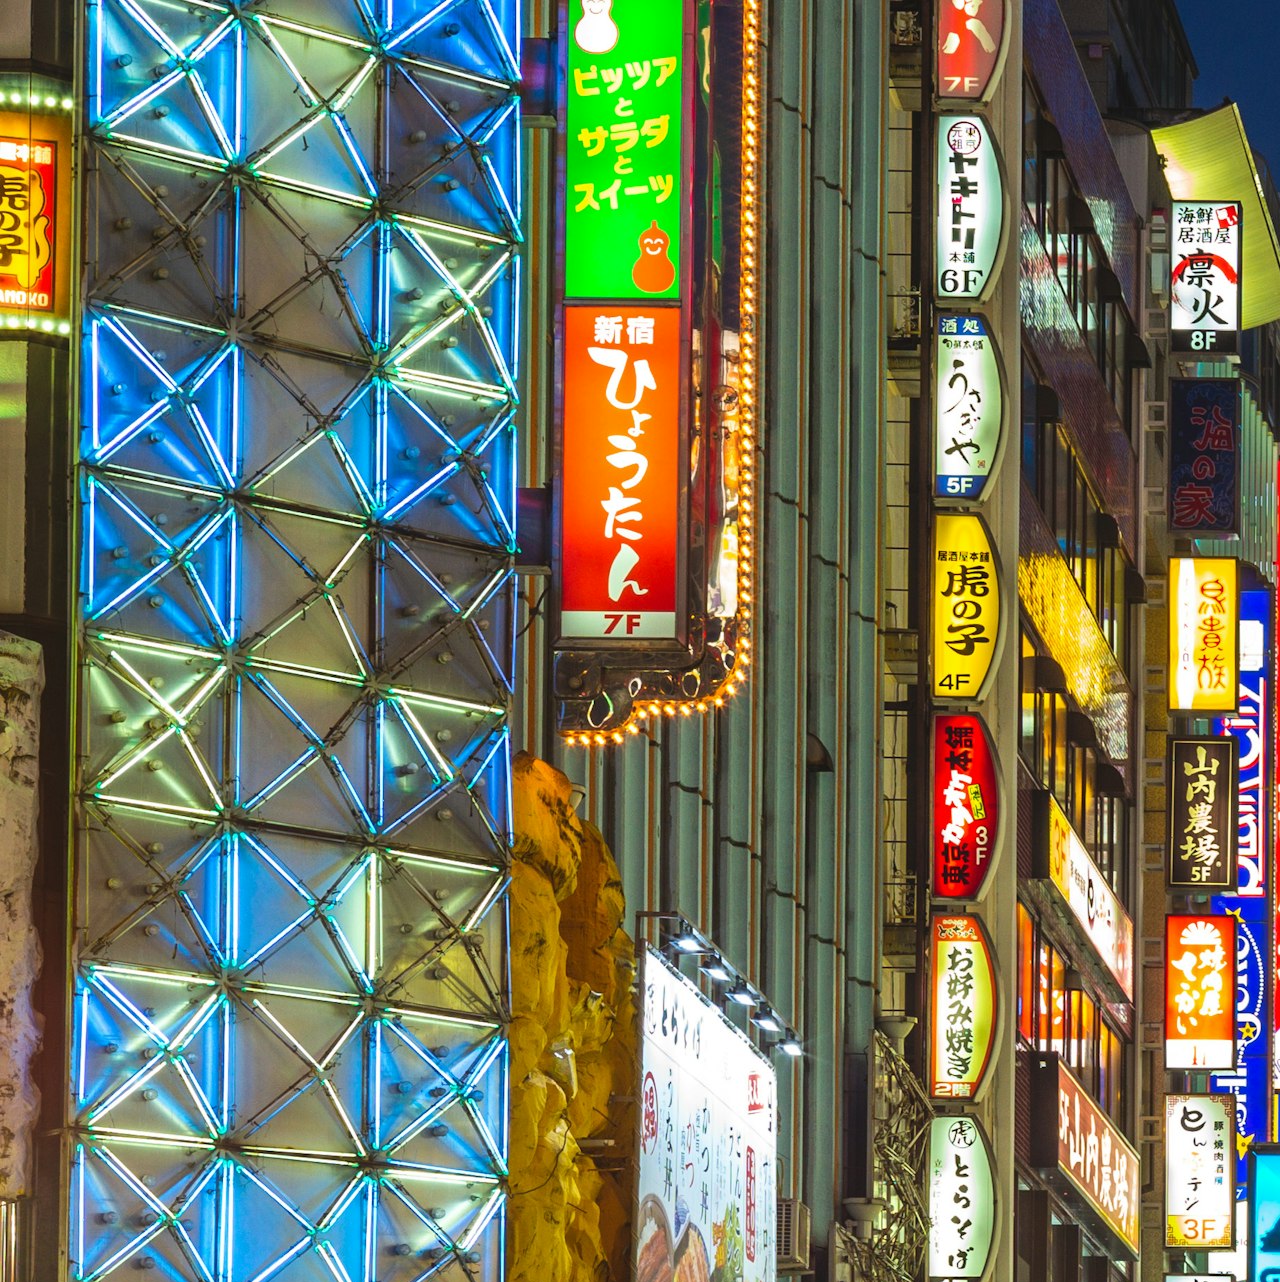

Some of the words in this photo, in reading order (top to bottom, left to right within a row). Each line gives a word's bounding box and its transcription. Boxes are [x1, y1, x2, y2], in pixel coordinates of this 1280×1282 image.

[943, 76, 979, 92] 7F
[614, 97, 635, 117] と
[577, 114, 670, 158] サラダ
[613, 155, 634, 175] と
[573, 174, 674, 213] スイーツ
[1178, 207, 1214, 224] 海鮮
[1178, 227, 1232, 244] 居酒屋
[940, 269, 984, 293] 6F
[593, 316, 655, 343] 新宿
[941, 318, 981, 334] 酒処
[1190, 331, 1217, 350] 8F
[588, 346, 657, 603] ひょうたん
[946, 477, 974, 494] 5F
[941, 565, 990, 657] 虎の子
[603, 615, 641, 635] 7F
[938, 674, 971, 691] 4F
[1179, 745, 1222, 864] 山内農場
[1190, 865, 1212, 882] 5F
[944, 944, 976, 1080] お好み焼き
[934, 1081, 971, 1097] 2階
[950, 1154, 973, 1271] とらそば
[1183, 1219, 1216, 1240] 3F
